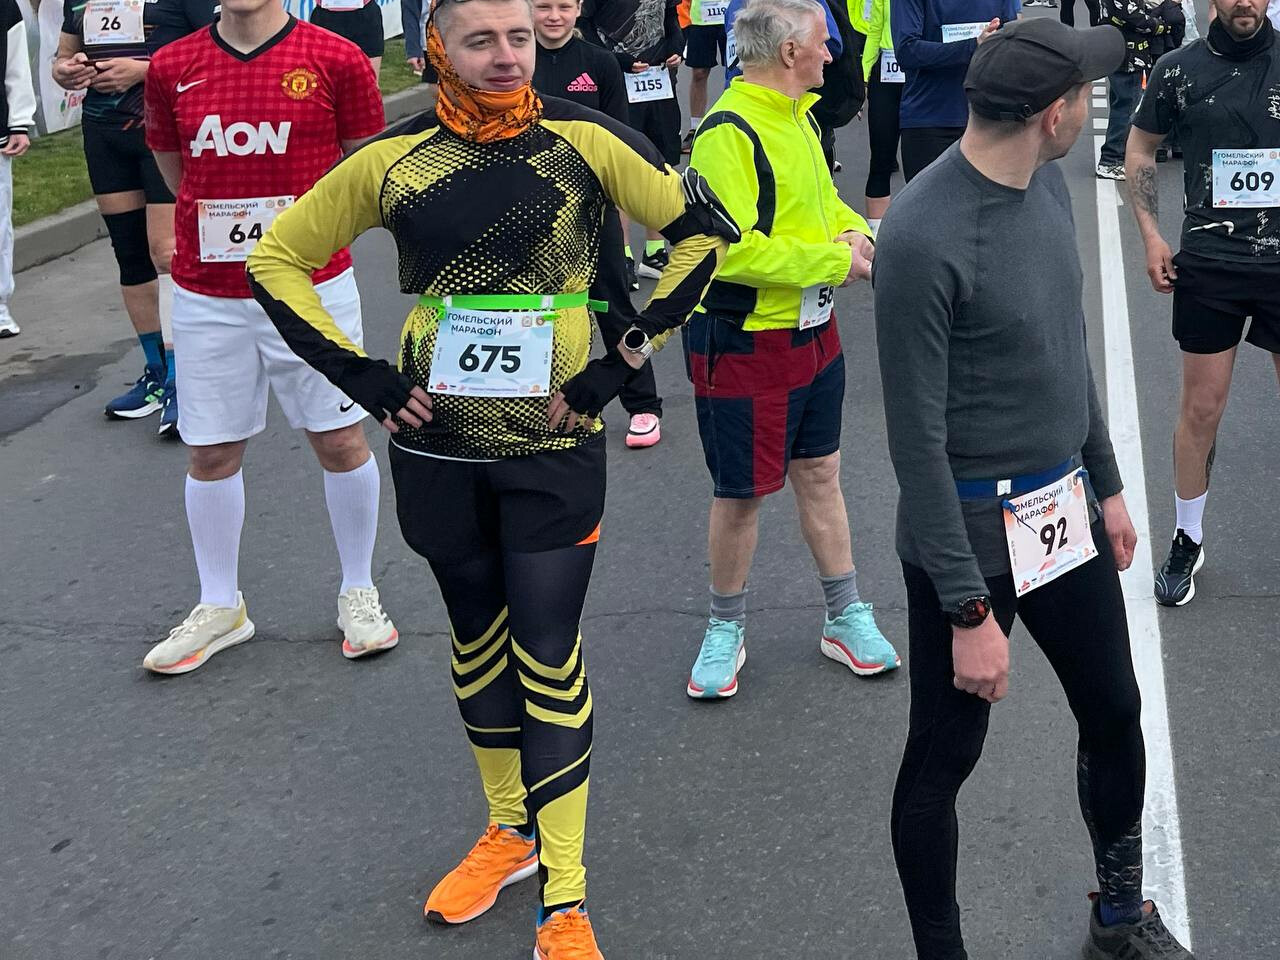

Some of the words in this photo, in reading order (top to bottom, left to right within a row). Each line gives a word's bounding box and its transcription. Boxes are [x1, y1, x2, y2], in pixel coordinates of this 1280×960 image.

[101, 16, 121, 31] 26
[567, 83, 597, 92] adidas
[634, 79, 662, 92] 1155
[190, 114, 292, 157] AON
[1230, 172, 1274, 191] 609
[203, 201, 258, 210] ГОМЕЛЬСКИЙ
[209, 210, 251, 218] МАРАФОН
[229, 223, 262, 244] 64
[448, 313, 512, 325] ГОМЕЛЬСКИЙ
[451, 325, 501, 336] МАРАФОН
[459, 344, 521, 374] 675
[1015, 486, 1063, 513] ОМЕЛЬСКИЙ
[1040, 517, 1068, 556] 92
